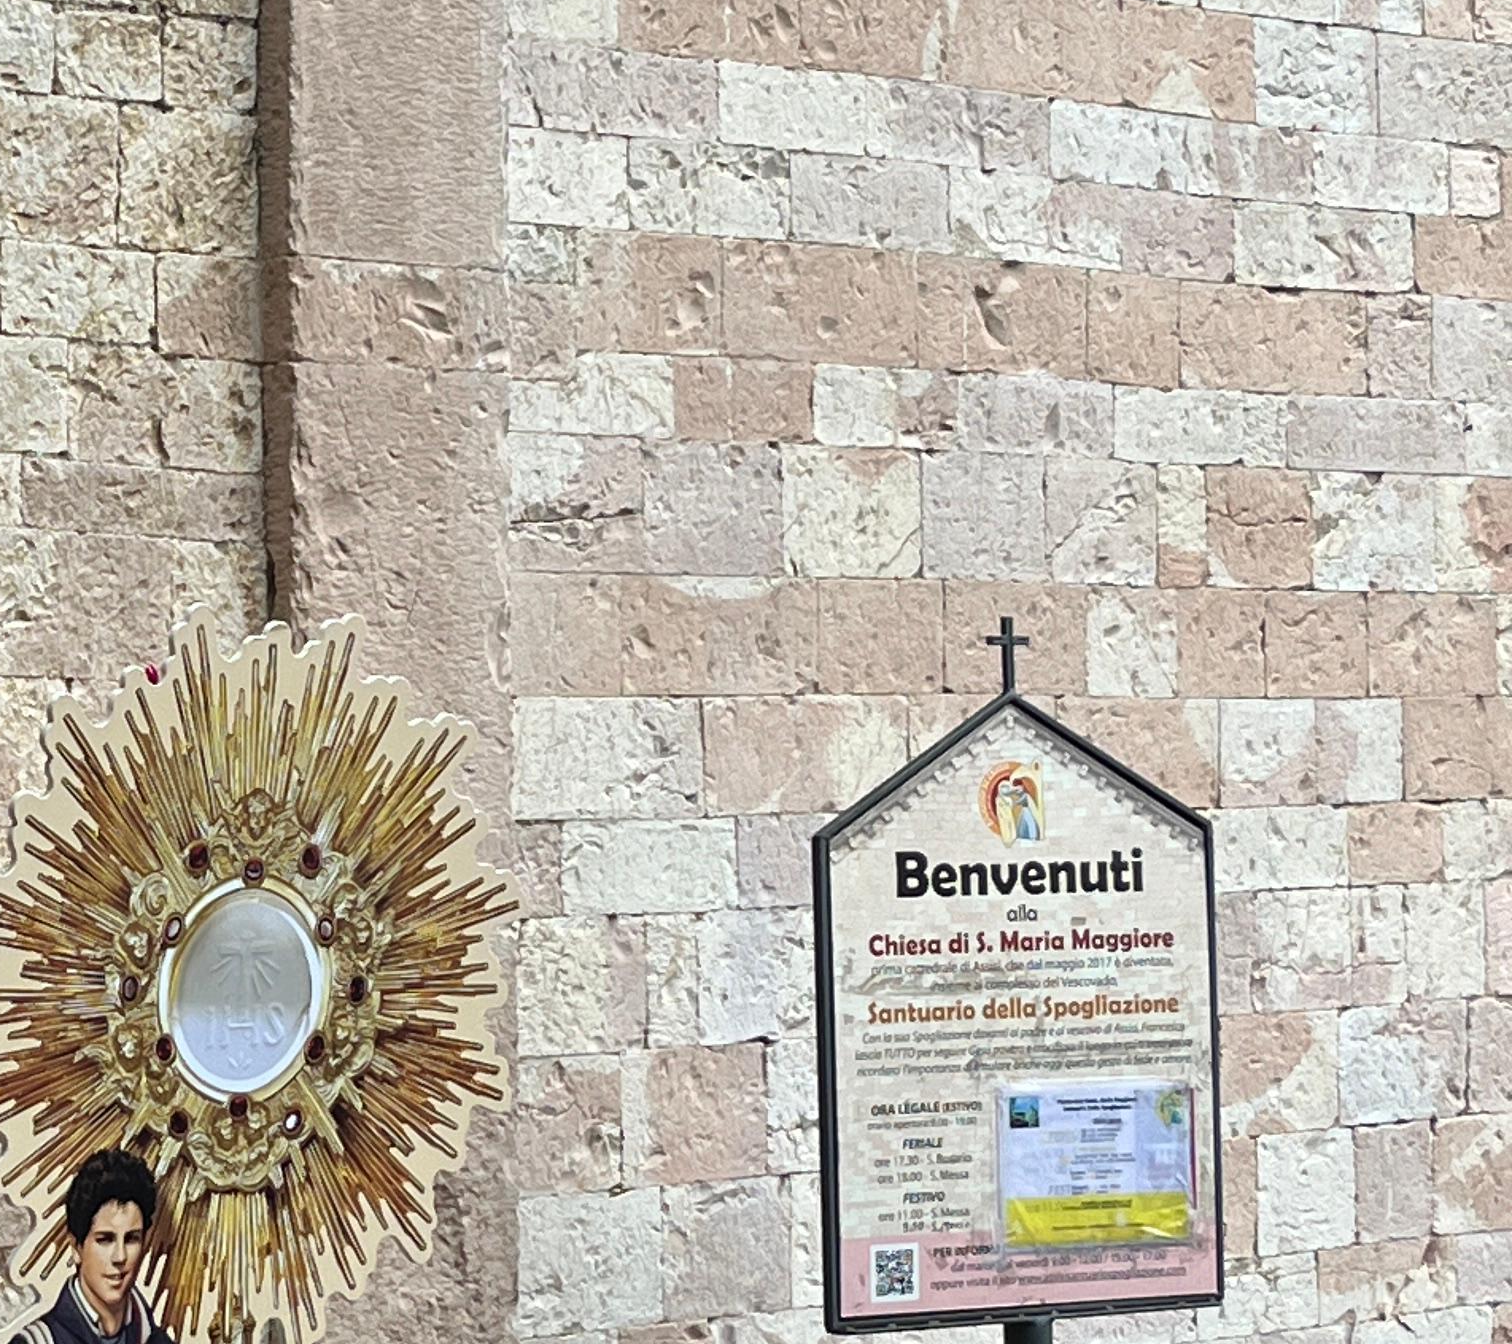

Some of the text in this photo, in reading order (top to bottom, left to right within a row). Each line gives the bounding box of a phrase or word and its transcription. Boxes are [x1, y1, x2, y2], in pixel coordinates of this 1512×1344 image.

[895, 847, 1144, 898] Benvenuti
[1007, 904, 1037, 922] alla
[869, 928, 1174, 956] Chiesa di S. Maria Maggiore
[1045, 958, 1085, 972] maggio
[1088, 957, 1112, 968] 2017
[868, 993, 1179, 1024] Santuario della Spogliazione
[871, 1104, 896, 1116] ORA
[898, 1101, 939, 1114] LEGALE
[903, 1137, 943, 1149] FERIALE
[933, 1247, 952, 1258] PER
